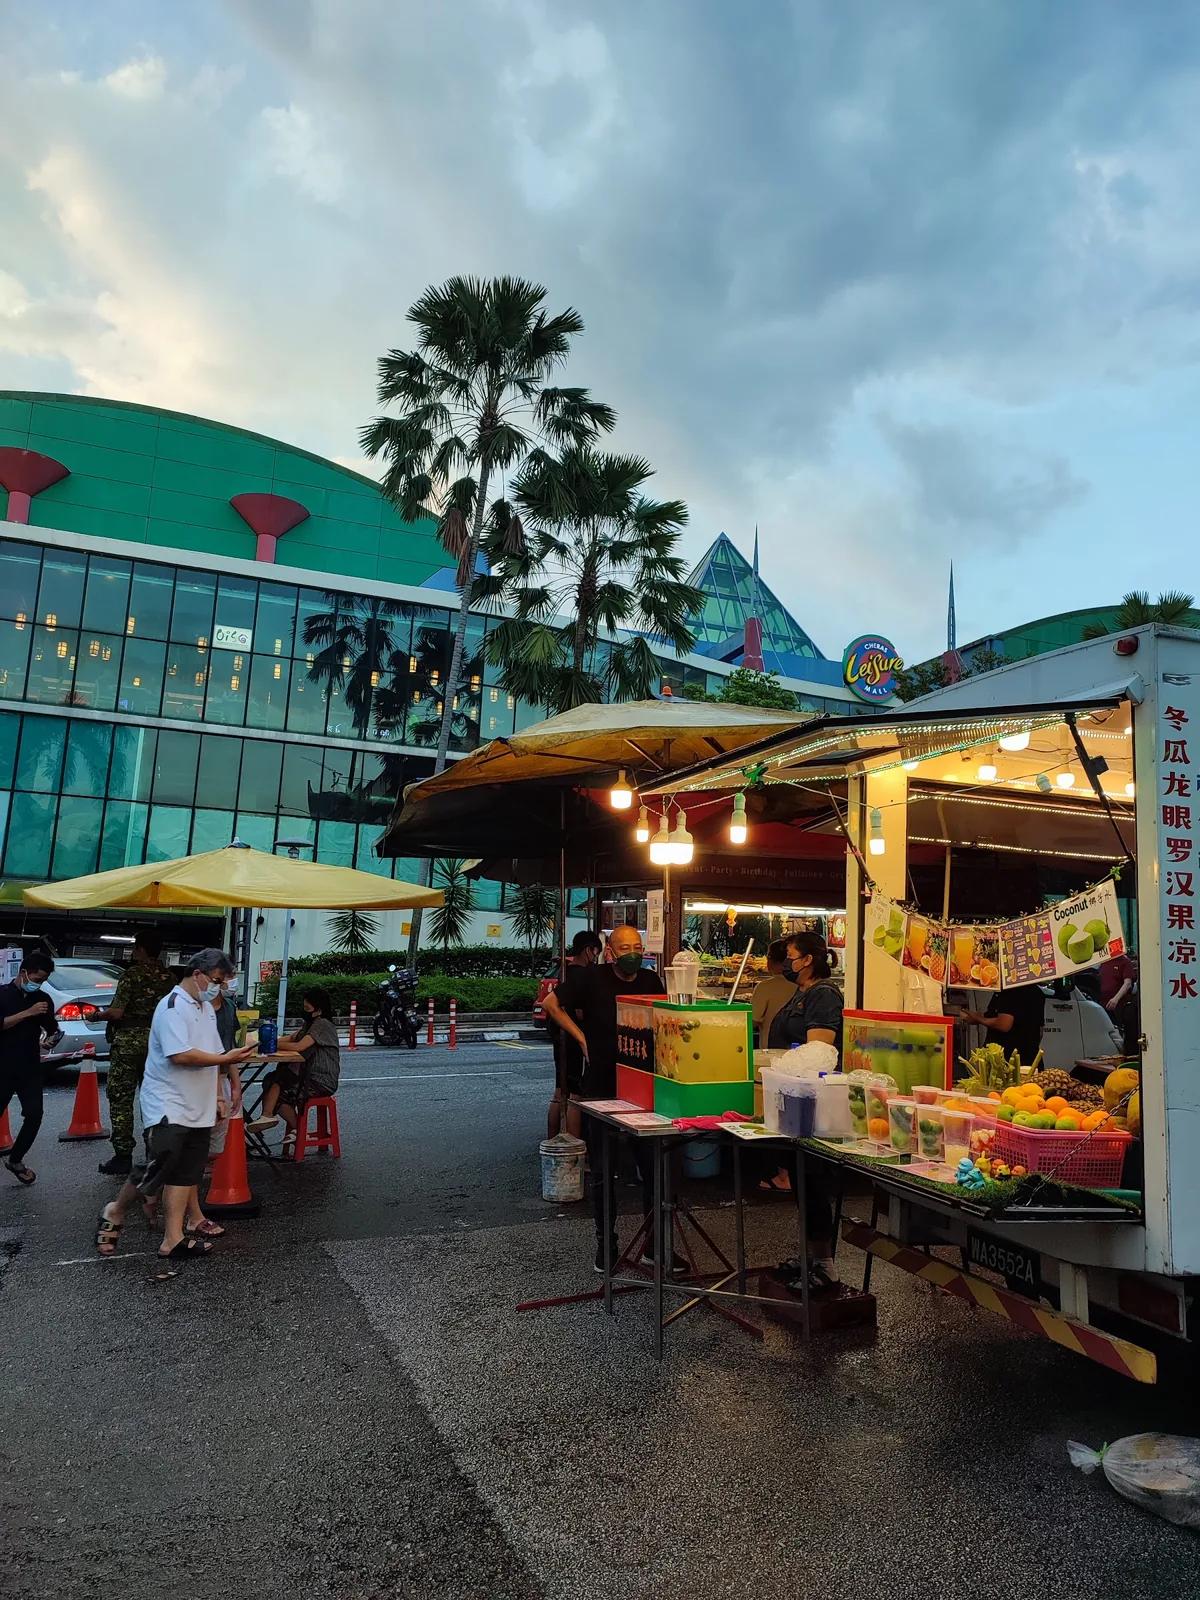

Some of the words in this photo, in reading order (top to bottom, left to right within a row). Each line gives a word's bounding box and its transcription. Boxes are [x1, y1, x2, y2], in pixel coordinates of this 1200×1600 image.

[864, 642, 888, 654] CHERAS
[846, 653, 904, 686] Leisure
[864, 685, 888, 695] MALL
[1162, 705, 1199, 1000] 冬瓜龙眼罗汉果凉水
[710, 865, 734, 876] Party
[741, 866, 777, 878] Birthday
[1054, 897, 1089, 921] Coconut
[971, 1235, 1034, 1285] WA3552A
